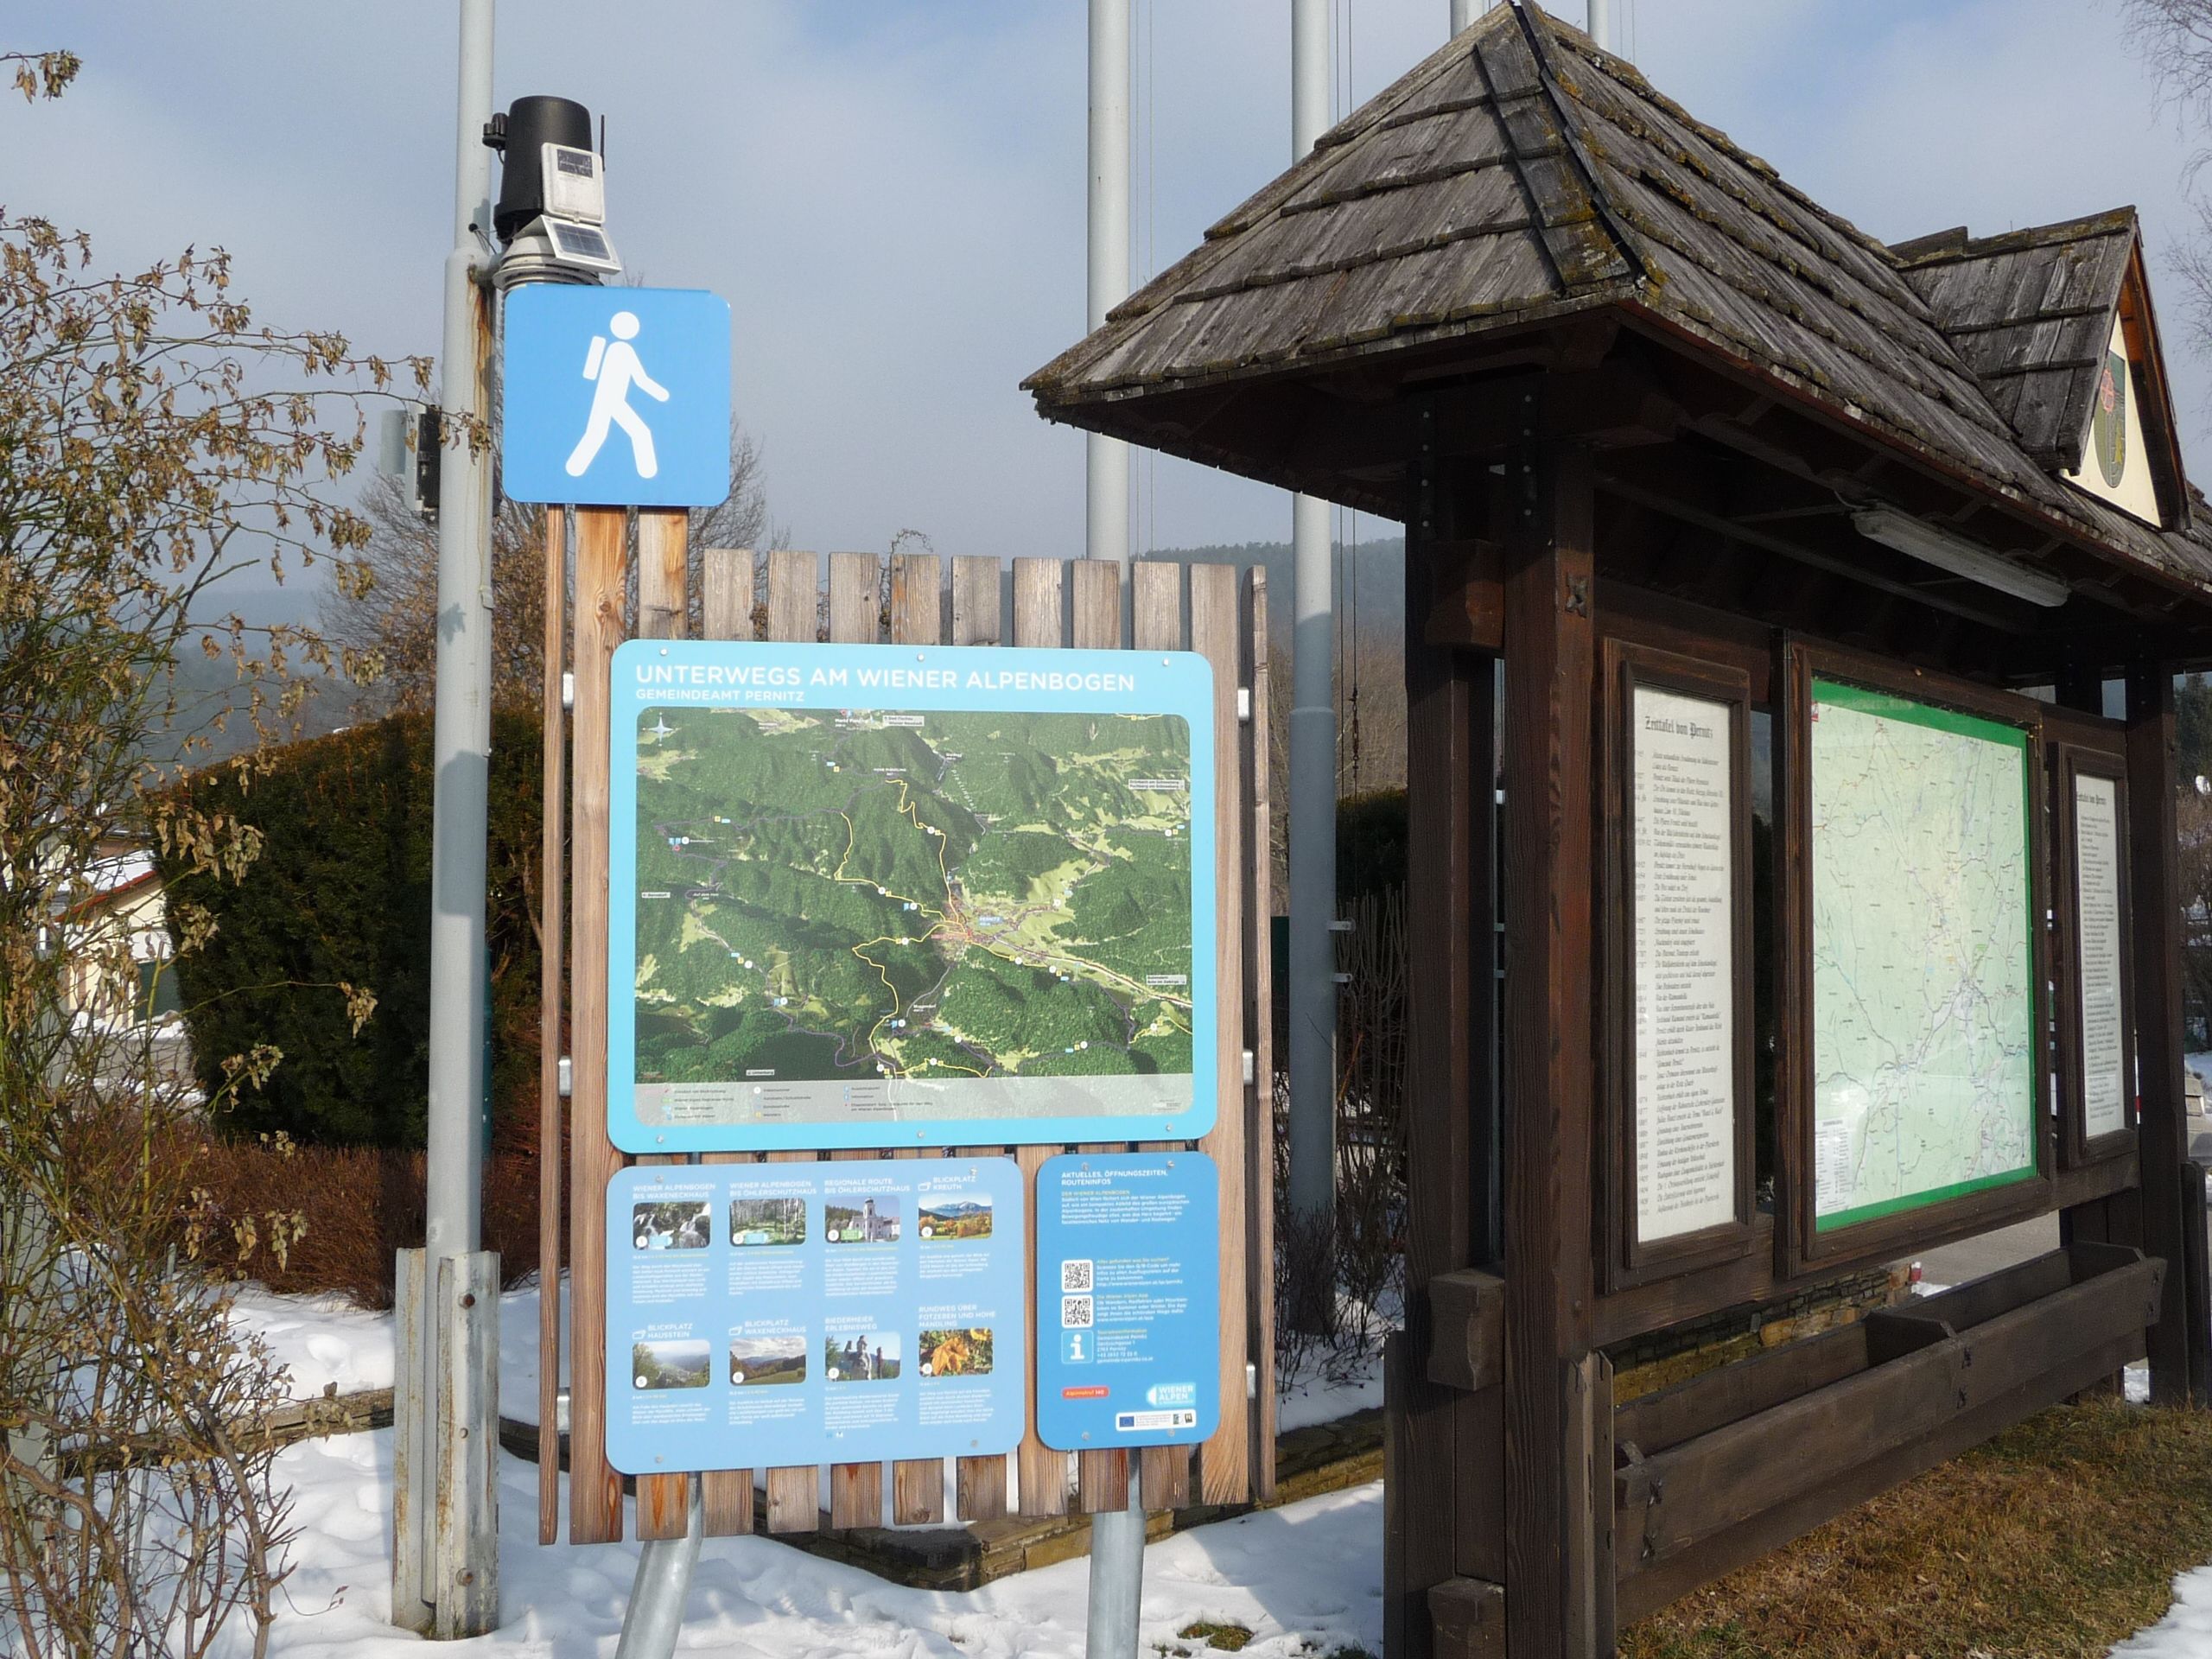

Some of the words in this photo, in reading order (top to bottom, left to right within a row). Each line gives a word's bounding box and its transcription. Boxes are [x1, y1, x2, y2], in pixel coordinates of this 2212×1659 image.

[636, 664, 800, 685] UNTERWEGS
[810, 669, 848, 687] AM
[857, 669, 957, 689] WIENER
[966, 671, 1135, 692] ALPENBOGEN
[636, 689, 741, 701] GEMEINDEAMT
[745, 690, 804, 702] PERNITZ
[744, 1187, 817, 1197] ÖHLERSCHUTZHAUS
[837, 1184, 911, 1193] ÖHLERSCHUTZHAUS
[957, 1303, 977, 1312] ÜBER
[824, 1316, 874, 1325] BIEDERMEIER
[1160, 1385, 1193, 1394] WIENER
